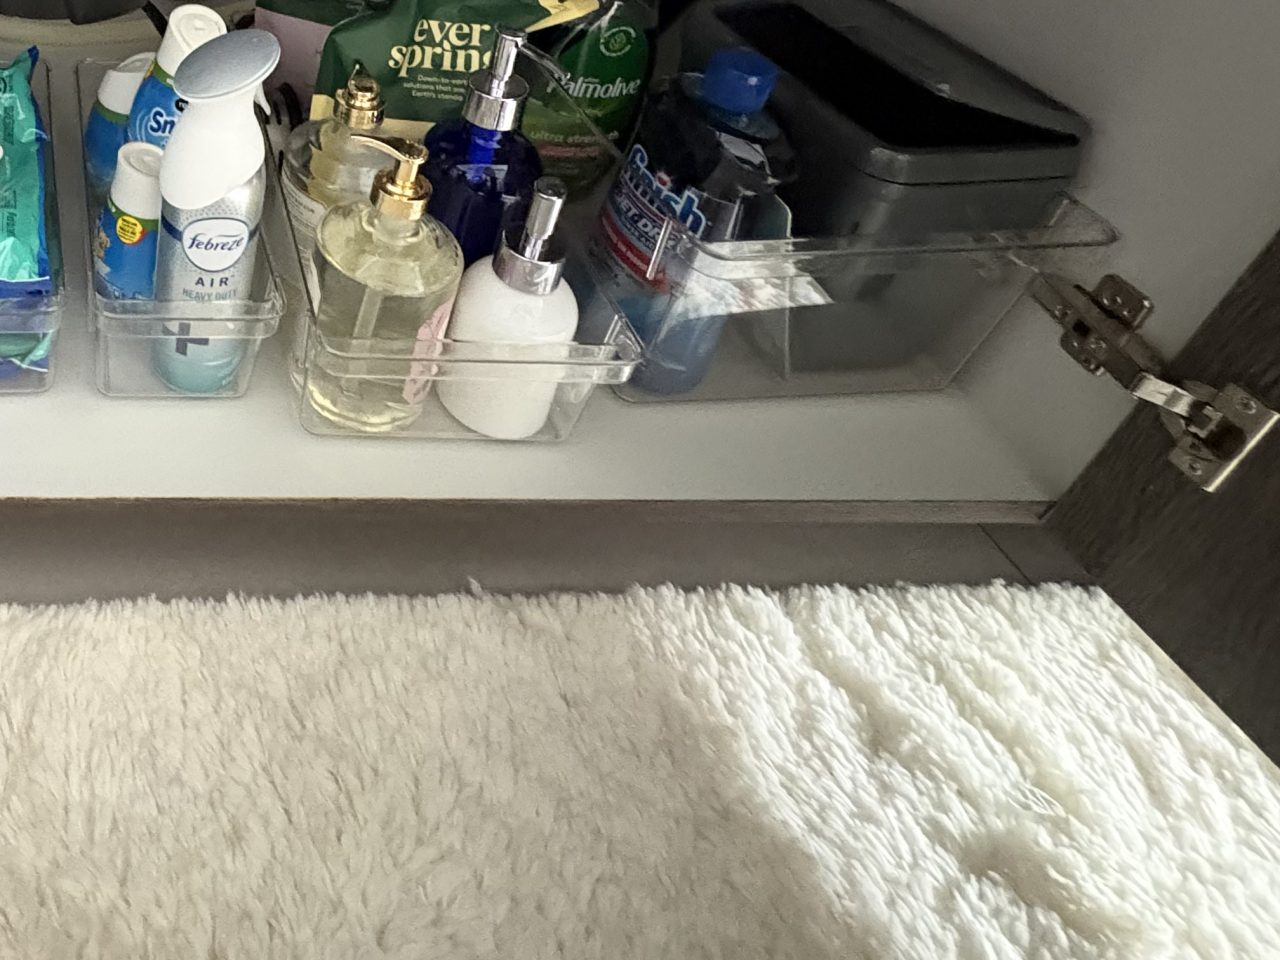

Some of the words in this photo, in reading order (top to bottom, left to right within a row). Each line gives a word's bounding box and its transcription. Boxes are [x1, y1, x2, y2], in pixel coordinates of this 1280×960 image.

[413, 19, 491, 47] ever
[148, 108, 177, 136] Sn
[195, 276, 230, 288] AIR
[183, 288, 213, 302] HEAVY
[215, 288, 239, 301] DUTY
